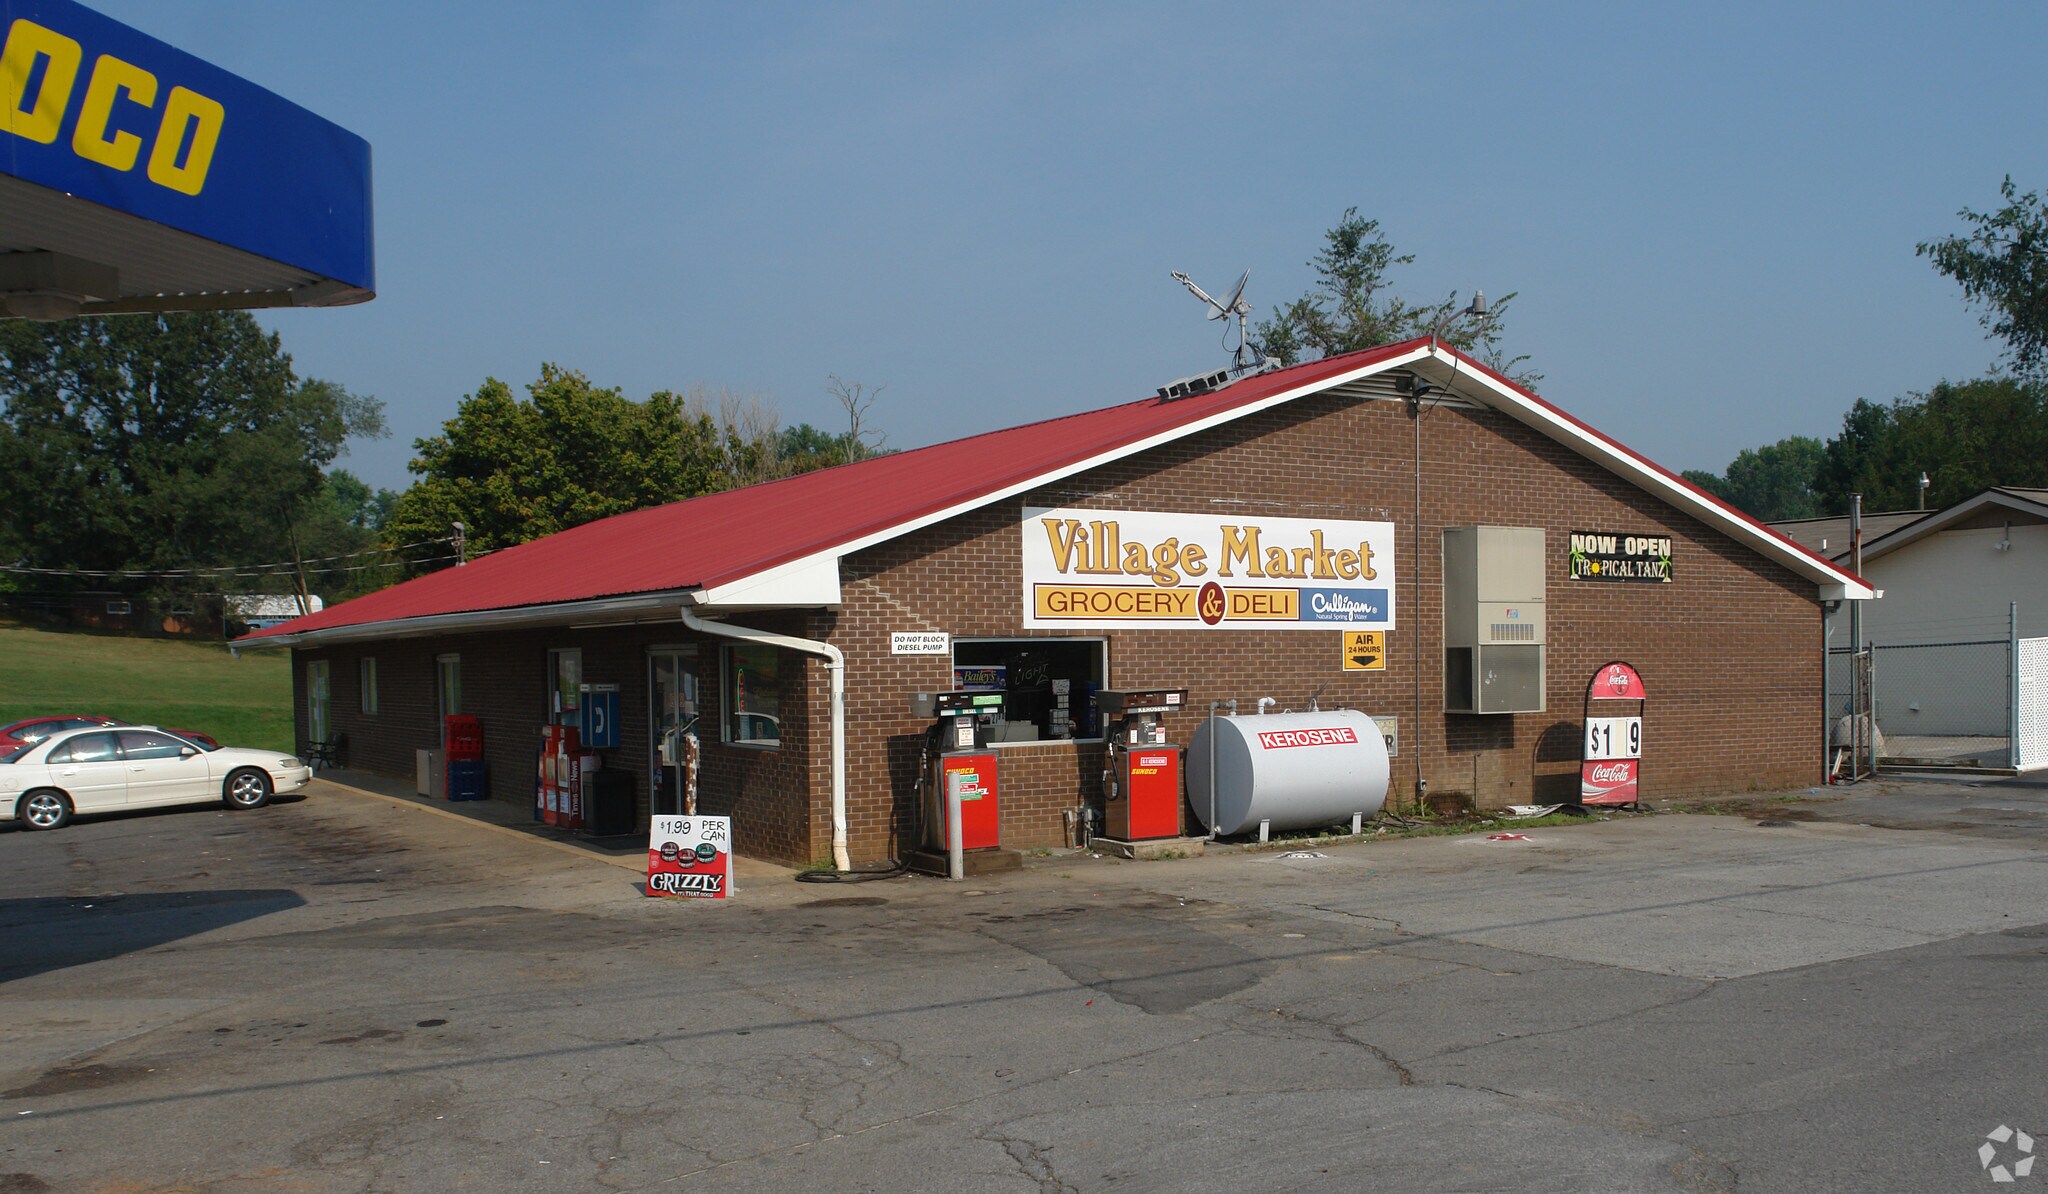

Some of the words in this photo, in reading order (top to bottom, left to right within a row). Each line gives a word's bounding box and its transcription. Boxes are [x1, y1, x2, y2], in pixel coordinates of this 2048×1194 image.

[1041, 518, 1208, 587] Village
[1217, 525, 1377, 581] Market
[1571, 534, 1617, 554] NOW
[1625, 537, 1671, 556] OPEN
[1636, 561, 1665, 577] TANZ
[1047, 591, 1190, 613] GROCERY
[1202, 588, 1222, 618] &
[1233, 594, 1288, 614] DELI
[1333, 613, 1347, 621] Spring
[1355, 635, 1374, 645] AIR
[1261, 729, 1355, 748] KEROSENE
[660, 820, 692, 834] $1.99
[702, 820, 725, 830] PER
[701, 831, 726, 841] CAN
[649, 872, 723, 894] GRIZZLY
